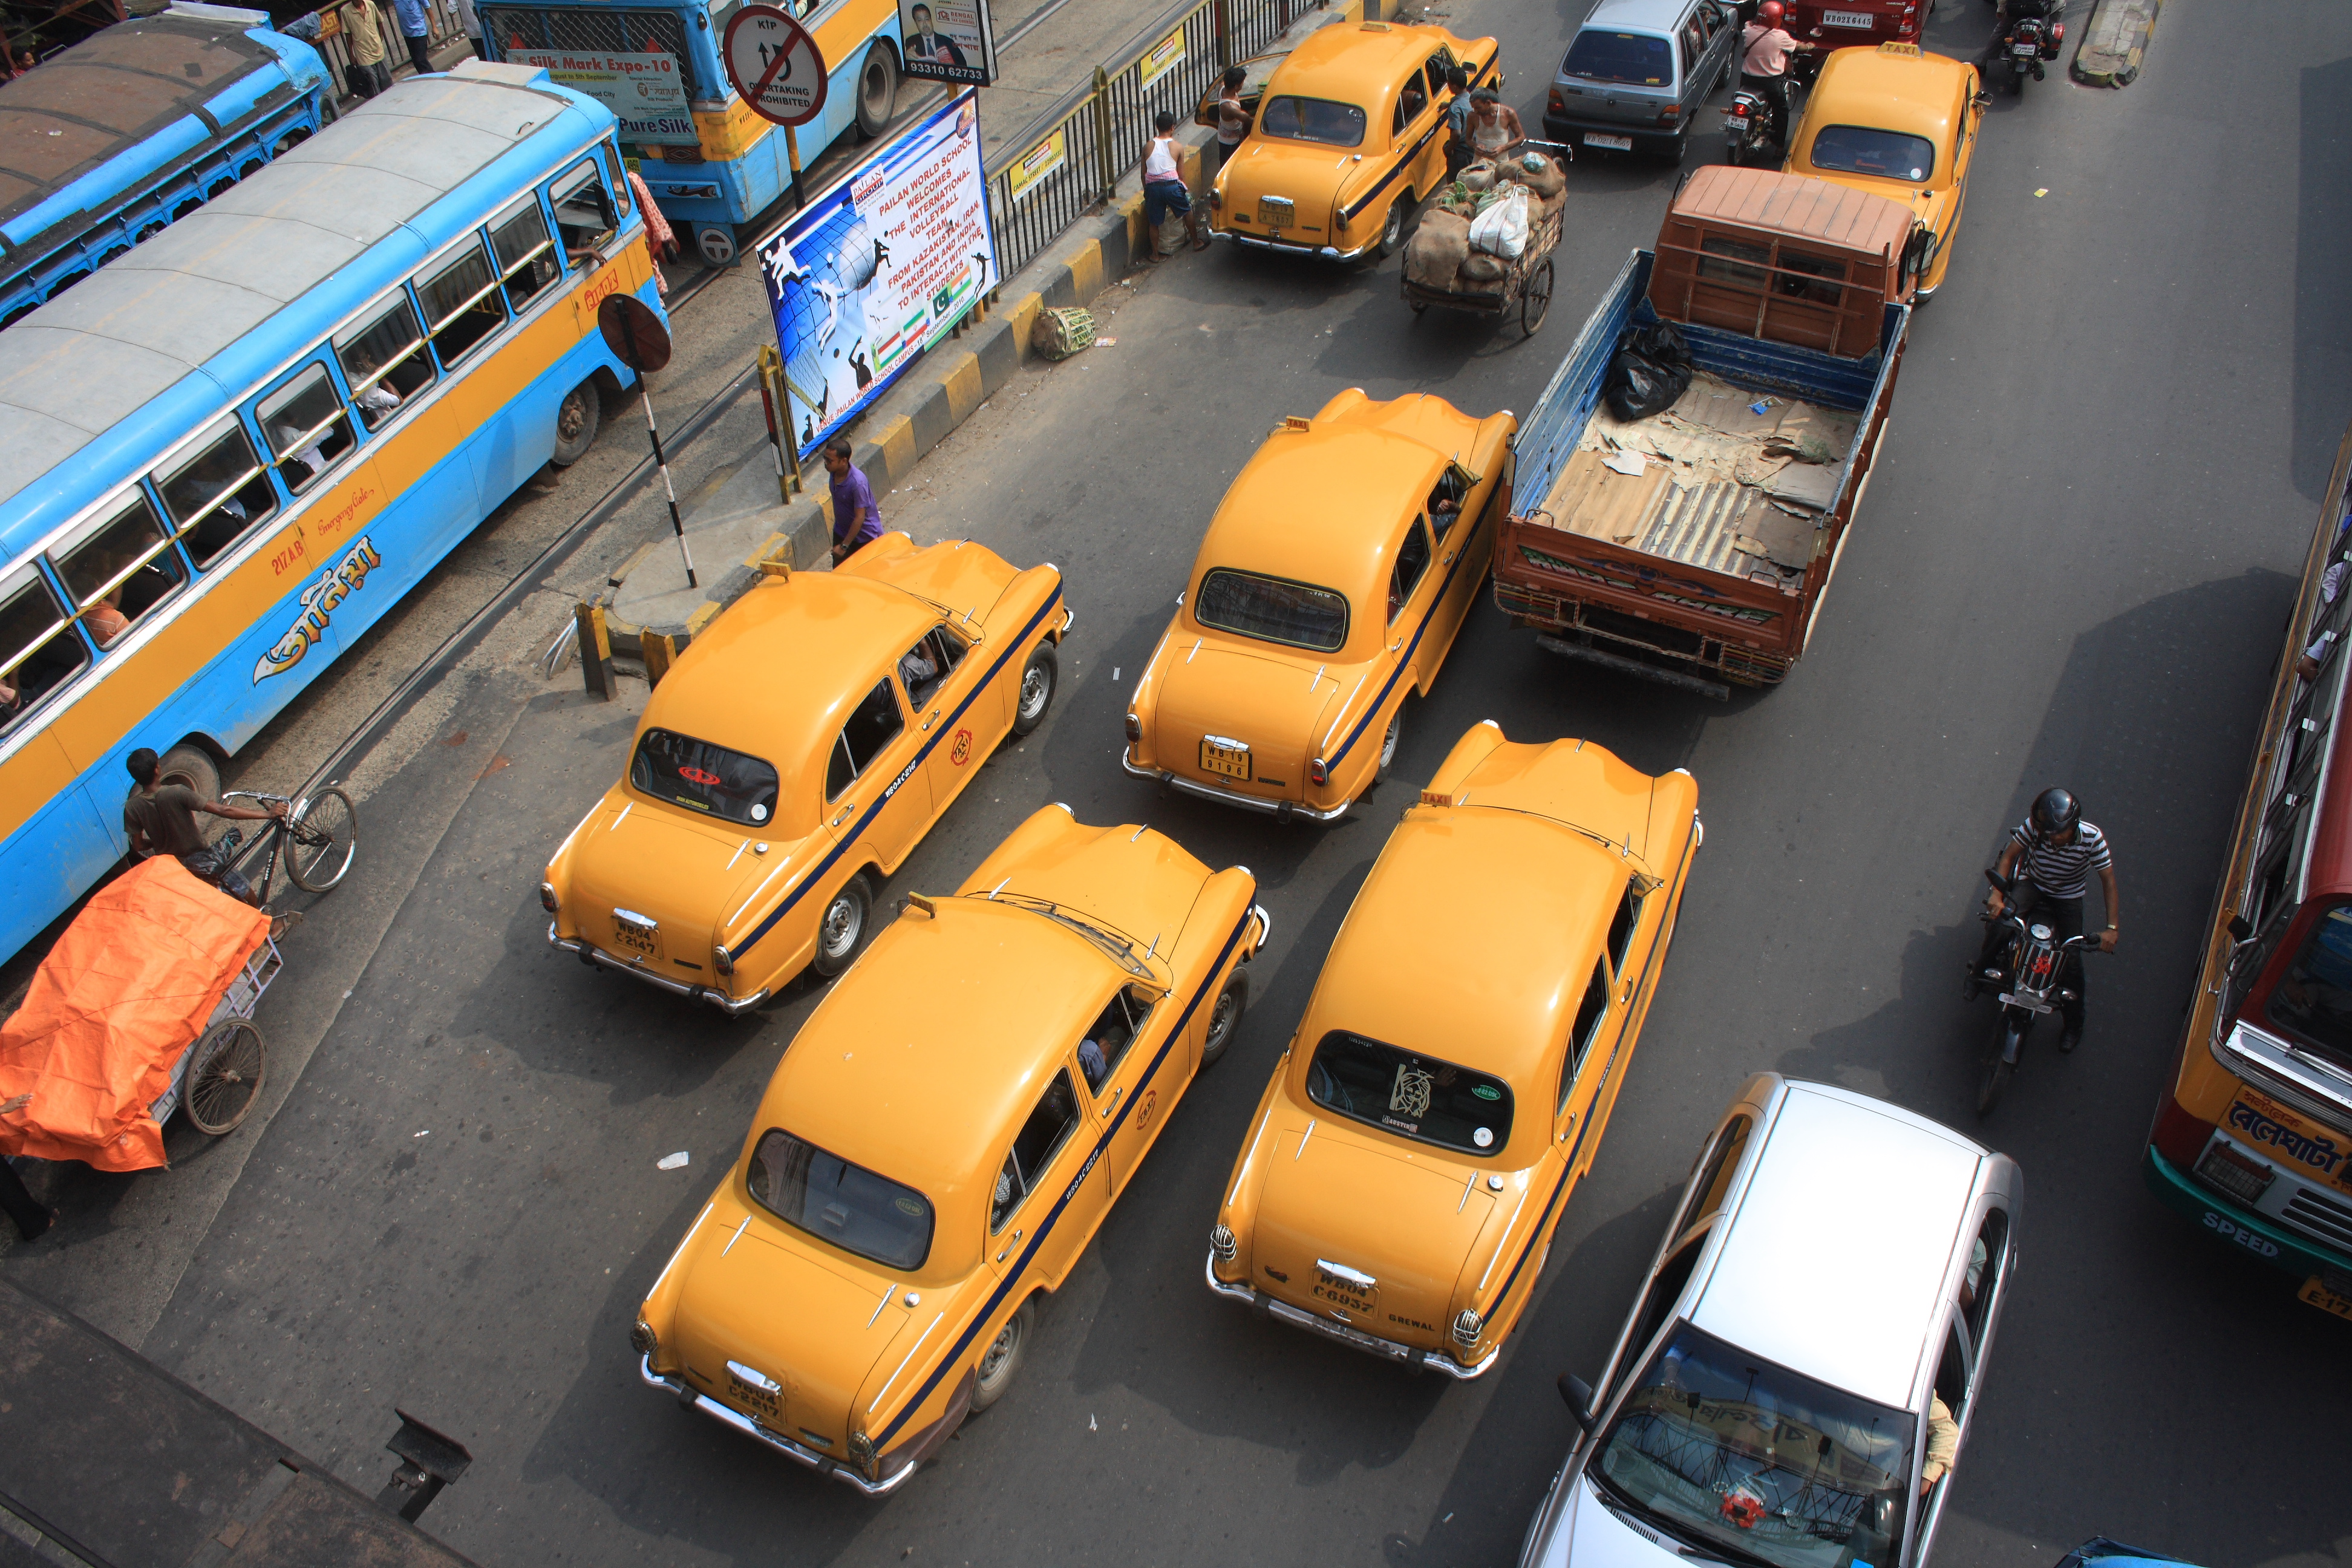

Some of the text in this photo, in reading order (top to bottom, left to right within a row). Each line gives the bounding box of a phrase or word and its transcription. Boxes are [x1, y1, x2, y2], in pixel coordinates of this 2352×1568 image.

[1884, 43, 1916, 54] TAXI
[528, 56, 671, 74] Silk Mark Expo-10
[910, 62, 983, 80] 93310 62733
[1143, 69, 1155, 82] CAMAC
[1155, 59, 1166, 73] STREET
[618, 117, 693, 134] Pure Silk
[1585, 134, 1596, 143] WB
[853, 169, 883, 197] PAILAN
[878, 187, 910, 217] PAILAN
[910, 162, 940, 192] WORLD
[941, 136, 973, 168] SCHOOL
[906, 168, 953, 211] WELCOMES
[1013, 176, 1028, 192] CAMAC
[1028, 167, 1041, 181] STREET
[855, 179, 884, 204] GROUP
[889, 220, 907, 240] THE
[909, 167, 971, 224] INTERNATIONAL
[909, 193, 959, 240] VOLLEYBALL
[926, 216, 949, 241] TEAM
[887, 263, 912, 290] FROM
[963, 200, 980, 223] IRAN,
[901, 218, 976, 293] PAKISTAN AND INDIA
[898, 226, 982, 311] TO INTERACT WITH THE
[926, 259, 964, 302] STUDENTS
[815, 413, 835, 433] VENUE
[855, 379, 875, 401] WORLD
[874, 363, 895, 385] SCHOOL
[894, 344, 915, 368] CAMPUS
[926, 313, 952, 339] September
[317, 487, 375, 537] Emergency Gate
[953, 734, 969, 759] TAXI
[1207, 759, 1243, 776] 9196
[1422, 792, 1448, 805] TAXI
[2227, 1099, 2346, 1175] বেলেঘাটা
[2202, 1211, 2279, 1259] SPEED
[1388, 1313, 1435, 1332] GREWAL
